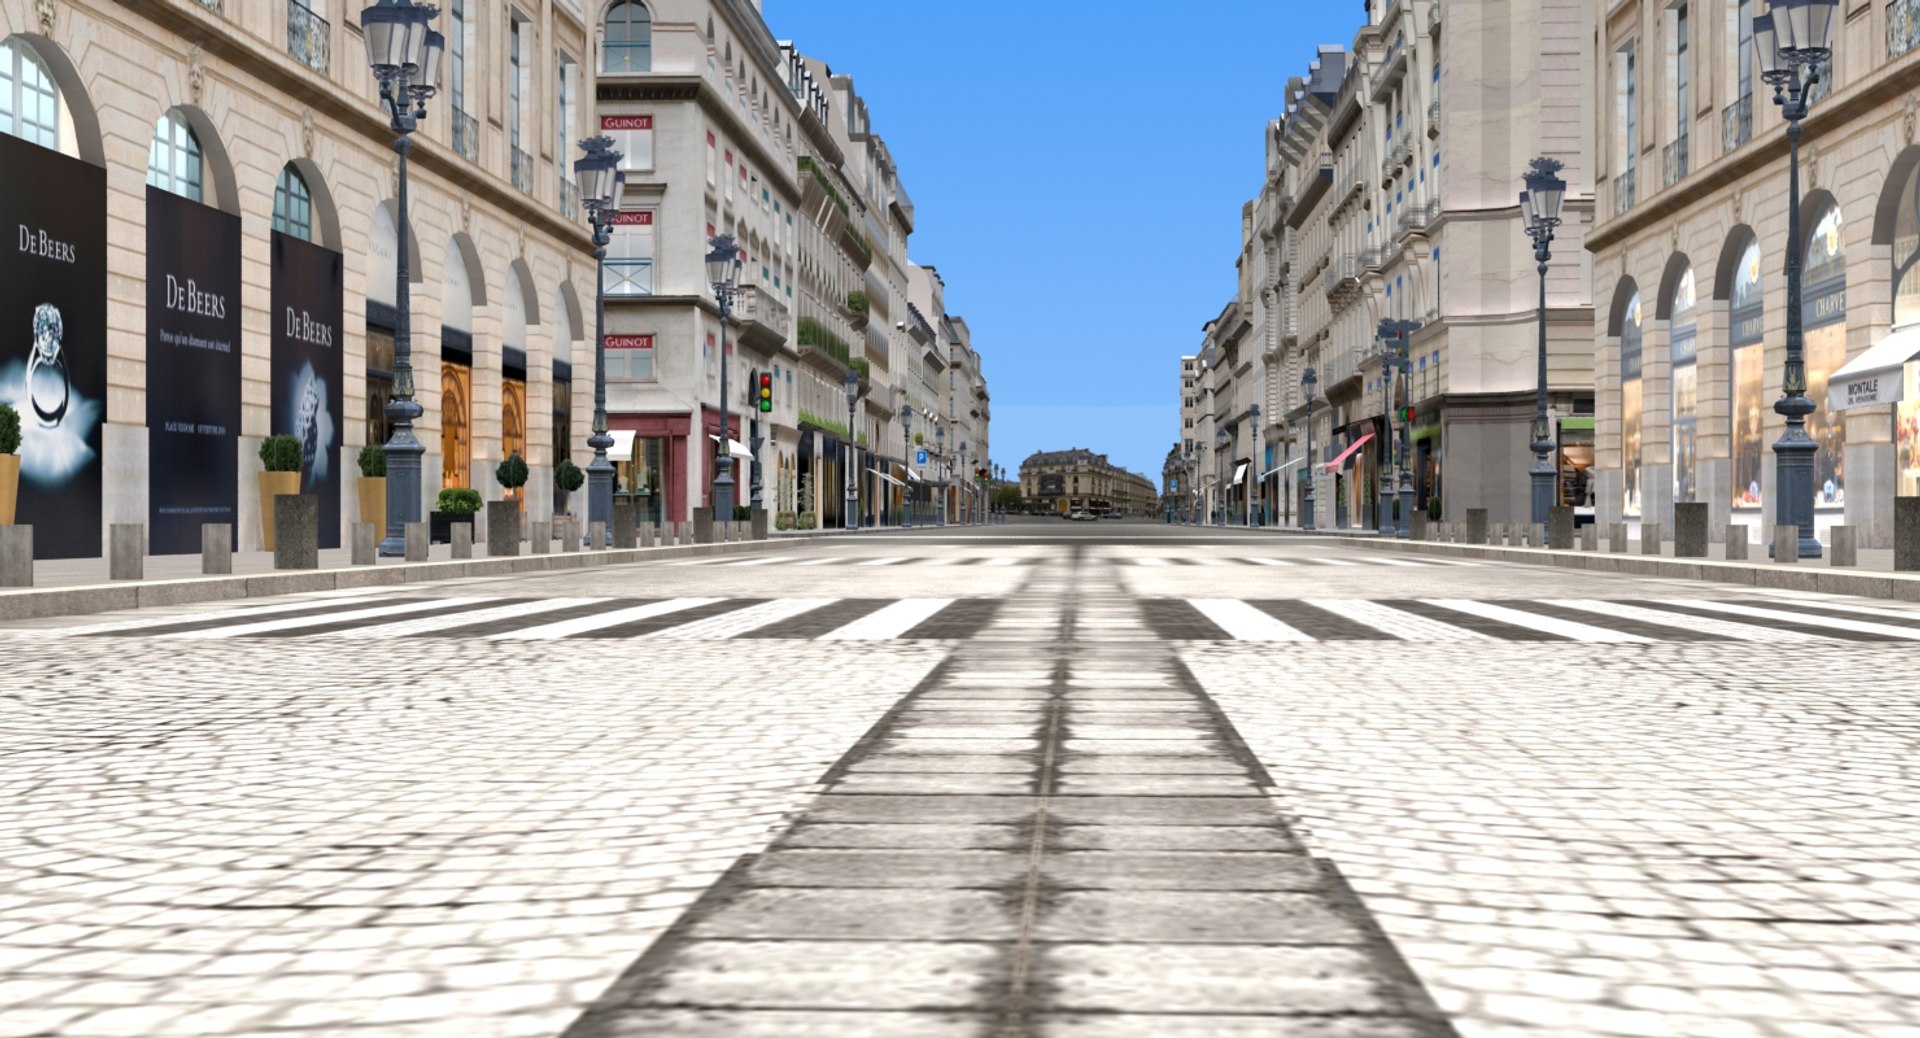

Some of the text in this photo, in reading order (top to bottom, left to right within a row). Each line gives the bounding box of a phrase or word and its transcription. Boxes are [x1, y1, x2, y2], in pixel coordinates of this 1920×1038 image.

[605, 117, 648, 129] GUINOT
[610, 213, 648, 224] UINOT
[39, 229, 76, 264] BEERS
[187, 279, 226, 319] BEERS
[303, 310, 332, 348] BEERS
[605, 336, 648, 348] GUINOT
[1847, 379, 1879, 396] MONTALE
